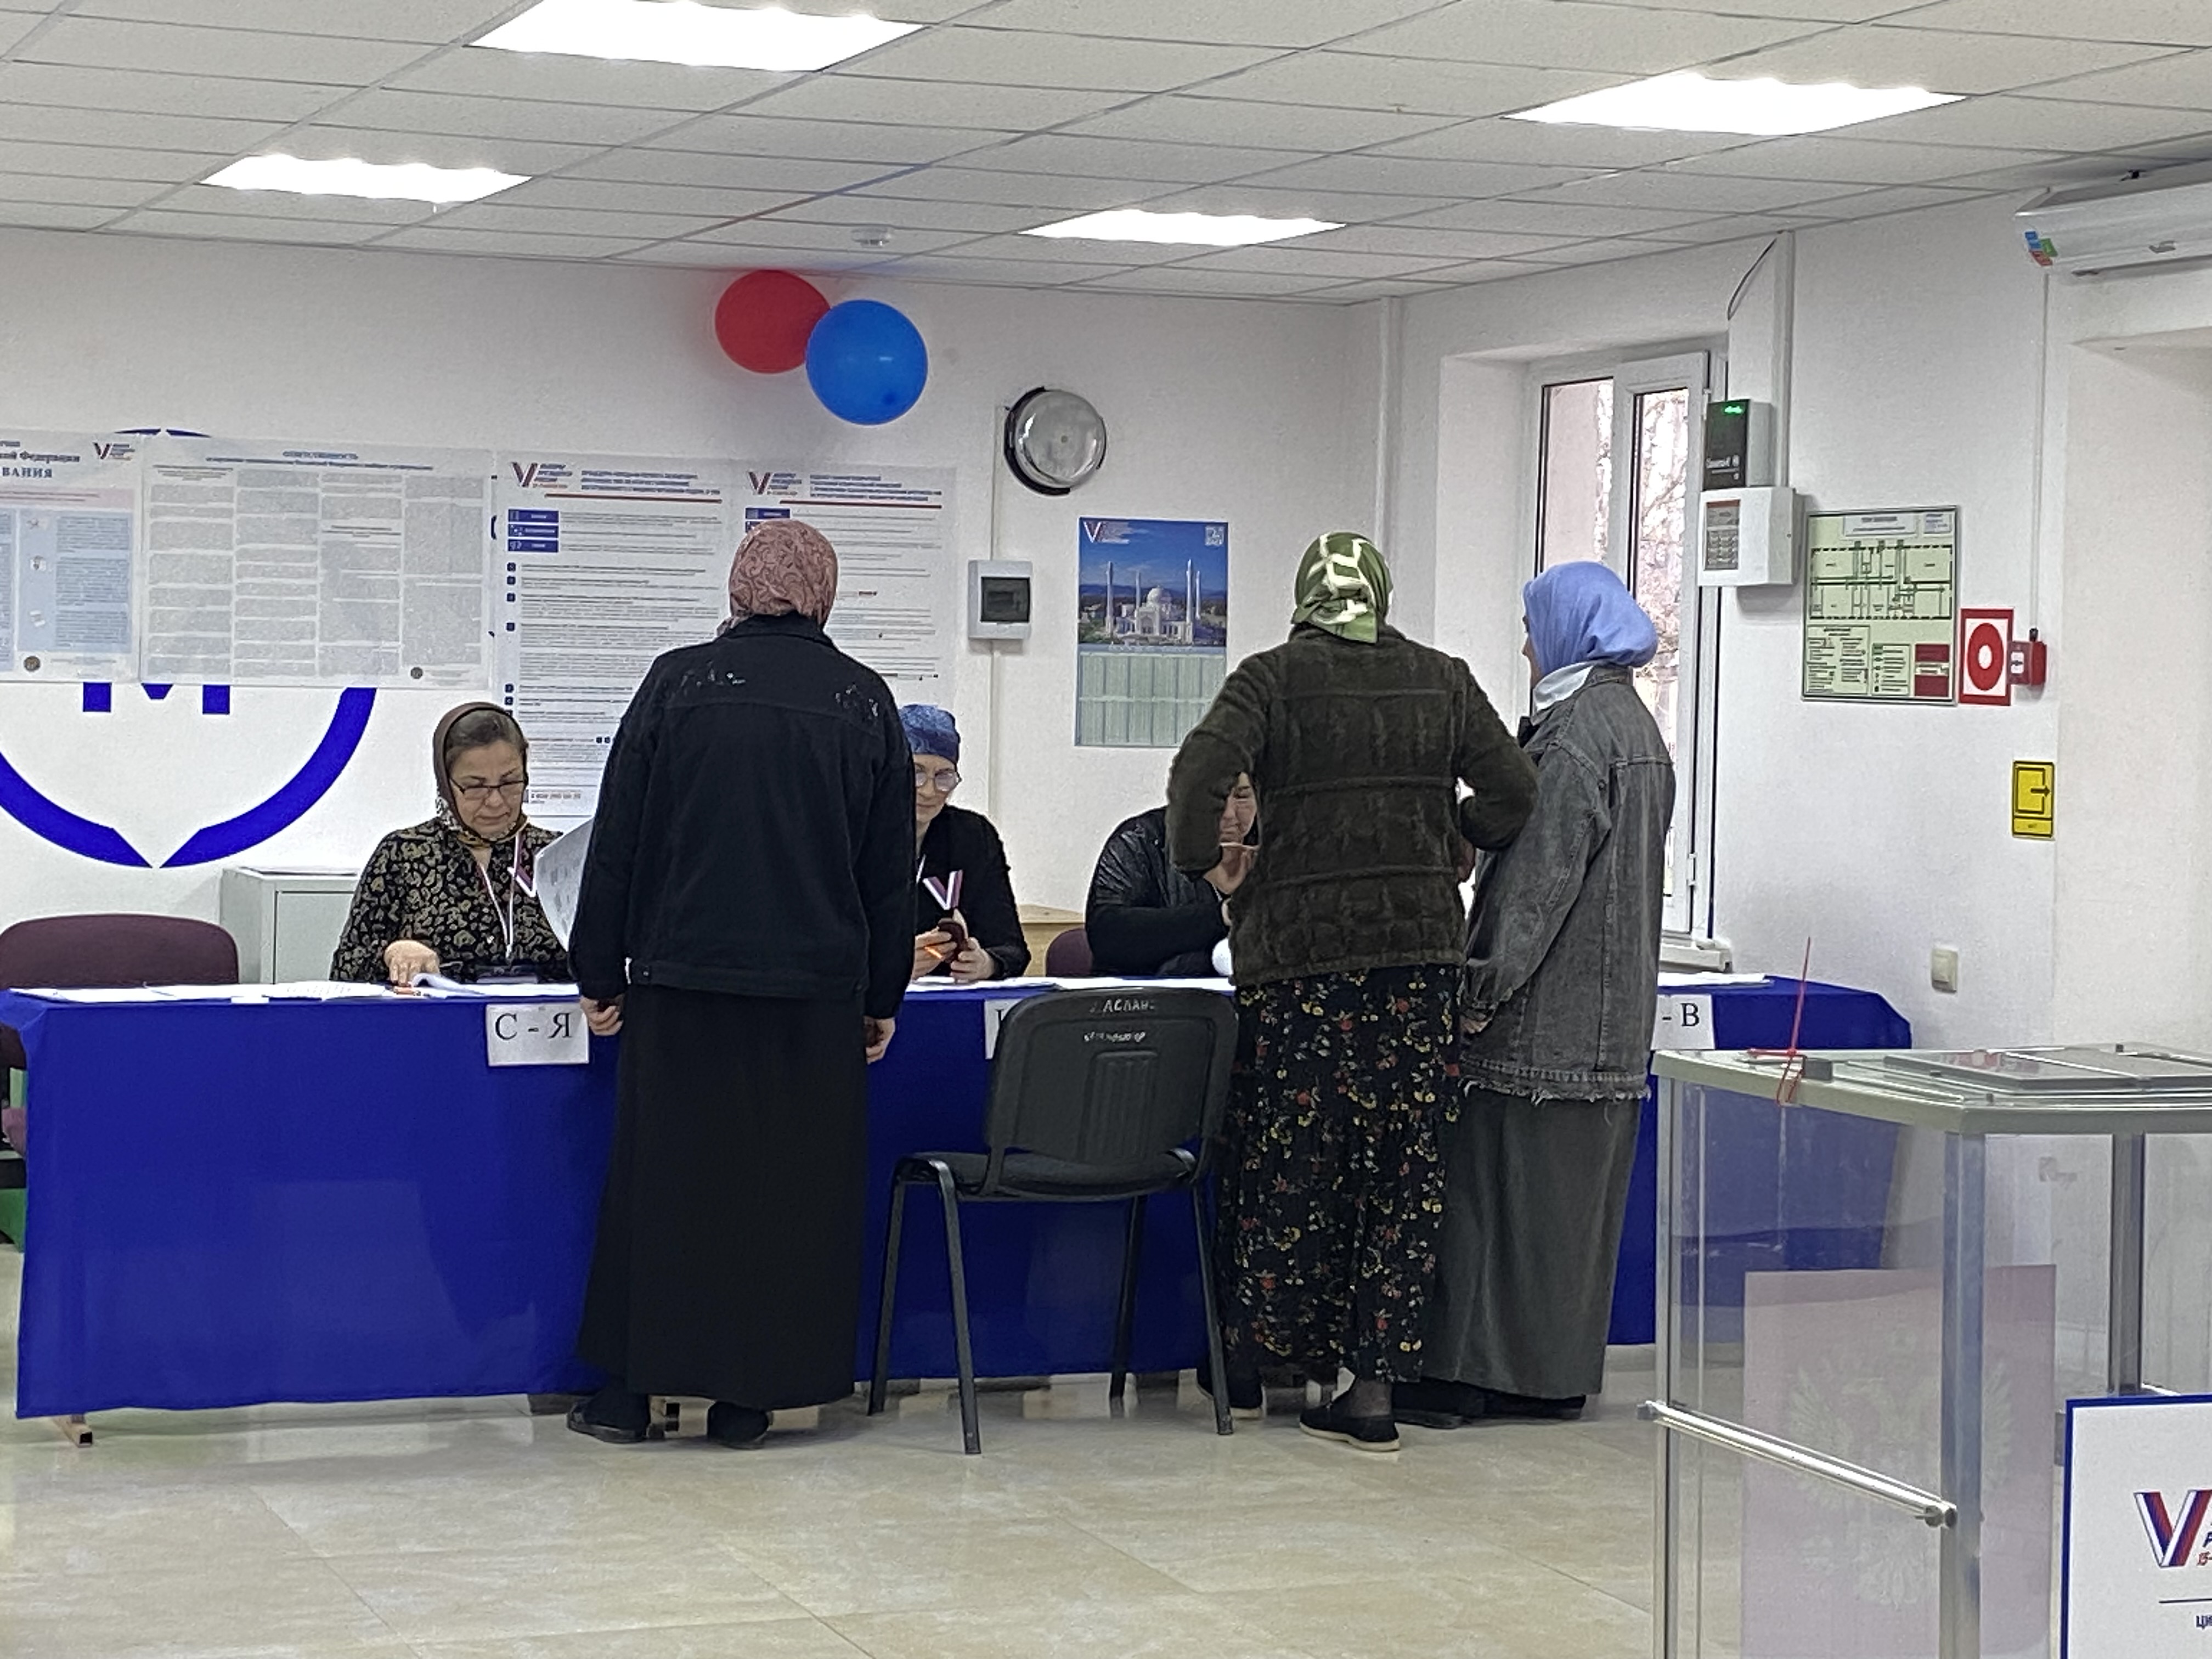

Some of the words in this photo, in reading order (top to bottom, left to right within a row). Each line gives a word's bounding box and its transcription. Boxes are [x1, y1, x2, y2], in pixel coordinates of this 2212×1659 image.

[495, 1013, 518, 1040] С
[548, 1013, 572, 1038] Я
[1680, 1003, 1700, 1026] В
